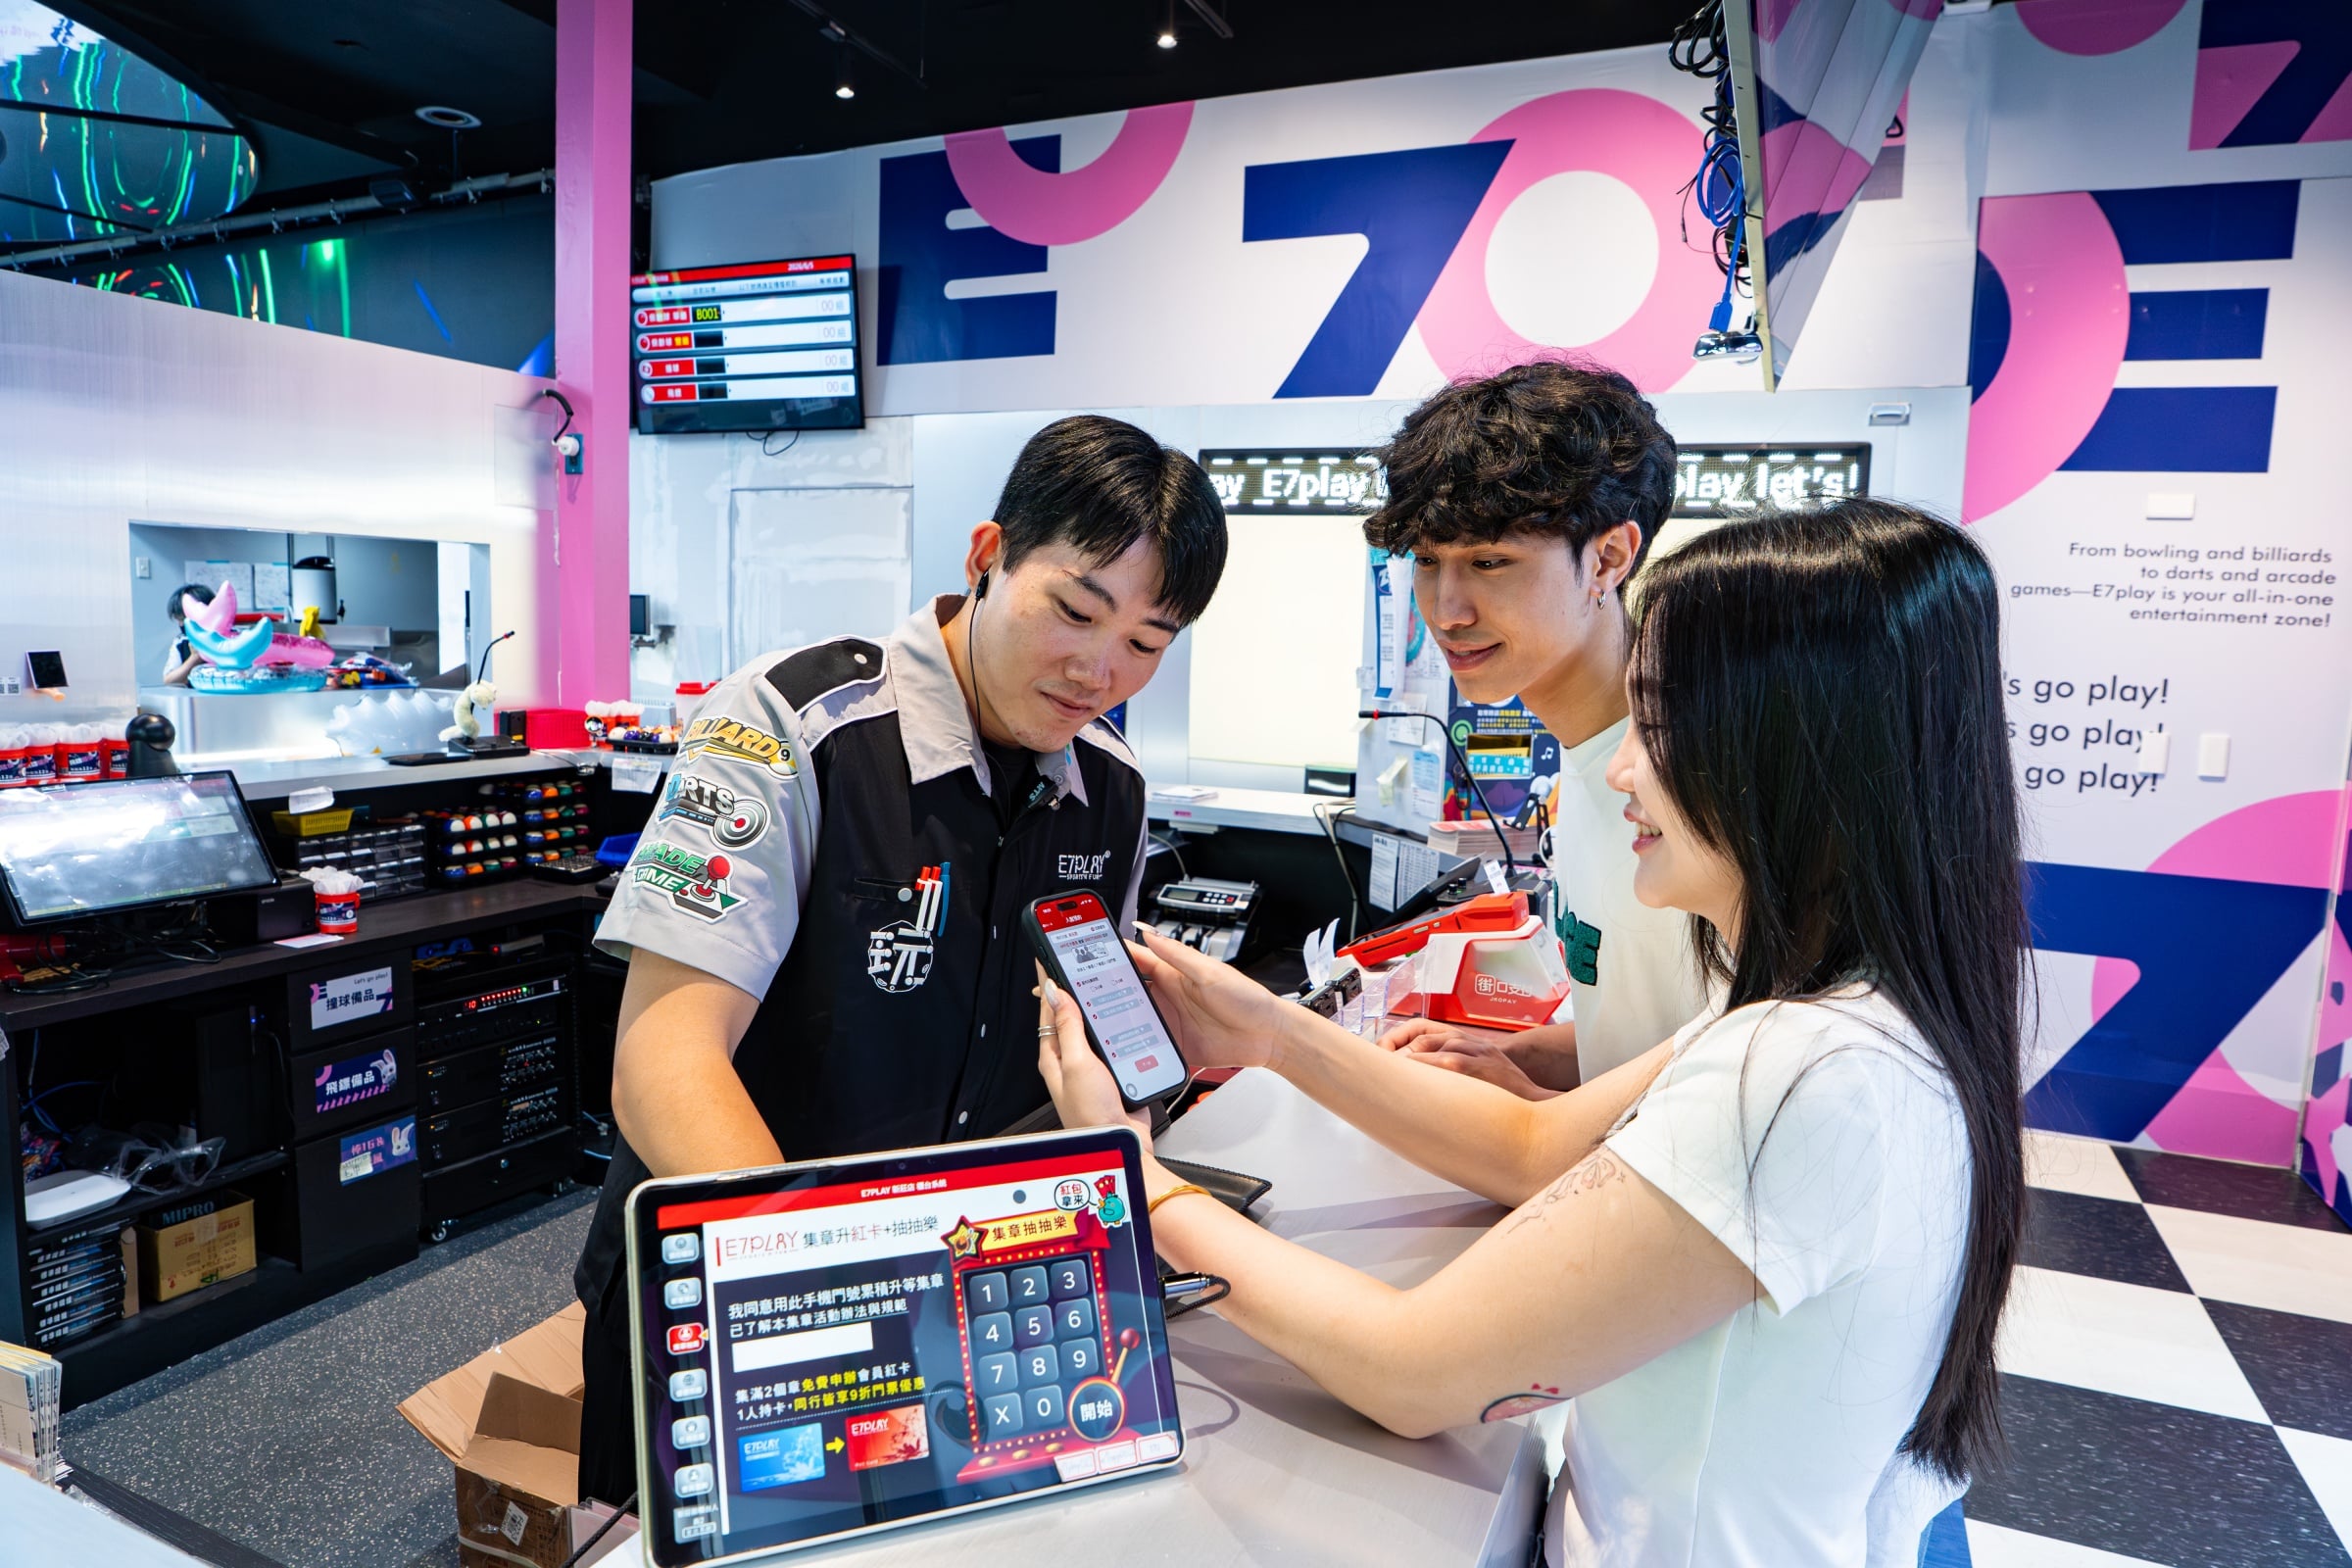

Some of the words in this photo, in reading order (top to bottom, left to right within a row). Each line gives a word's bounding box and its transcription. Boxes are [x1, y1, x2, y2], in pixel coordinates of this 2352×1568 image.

[1263, 466, 1370, 505] E7play
[2069, 542, 2117, 557] From
[2124, 544, 2199, 563] bowling
[2207, 546, 2244, 562] and
[2253, 546, 2332, 564] billiards
[2140, 566, 2159, 579] to
[2166, 565, 2214, 581] darts
[2221, 568, 2259, 583] and
[2266, 569, 2336, 585] arcade
[2162, 586, 2176, 600] is
[2182, 590, 2225, 605] your
[2232, 588, 2333, 607] all-in-one
[2130, 608, 2268, 624] entertainment
[2275, 612, 2330, 628] zone!
[2034, 679, 2075, 704] go
[2087, 675, 2169, 709] play!
[2030, 723, 2070, 746] go
[2025, 765, 2065, 789] go
[2078, 762, 2157, 797] play!
[860, 1187, 891, 1199] E7PLAY
[1059, 1183, 1083, 1196] 紅包
[162, 1200, 215, 1225] MIPRO
[804, 1213, 939, 1250] 集章升紅卡+抽抽樂
[992, 1215, 1067, 1242] 集章抽抽樂
[982, 1284, 992, 1302] 1
[1022, 1278, 1036, 1297] 2
[1062, 1271, 1076, 1290] 3
[986, 1324, 999, 1343] 4
[1028, 1316, 1042, 1336] 5
[1068, 1310, 1081, 1329] 6
[991, 1364, 1004, 1384] 7
[1032, 1357, 1047, 1376] 8
[1072, 1349, 1087, 1369] 9
[1037, 1397, 1052, 1417] 0
[1080, 1399, 1113, 1422] 開始
